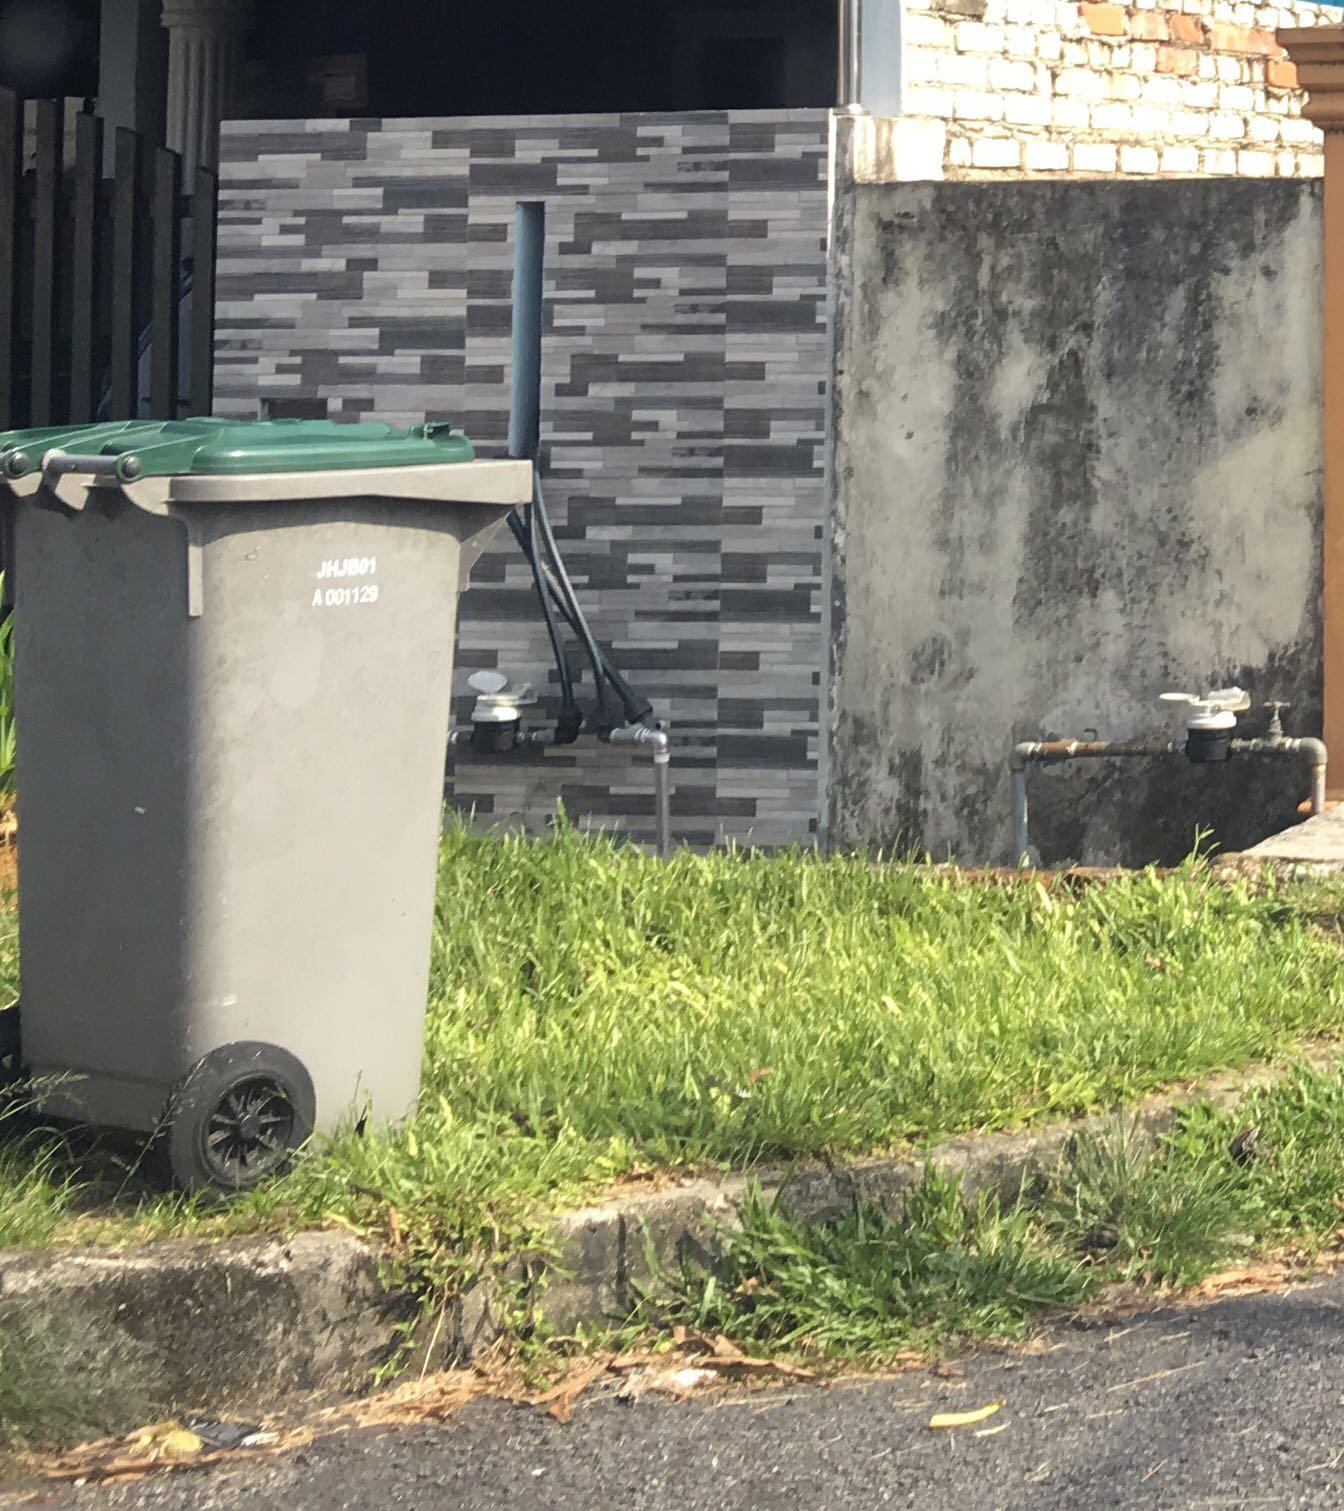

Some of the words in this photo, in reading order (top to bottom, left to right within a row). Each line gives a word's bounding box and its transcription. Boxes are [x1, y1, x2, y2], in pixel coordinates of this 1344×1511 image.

[316, 556, 376, 579] JHJB01
[311, 588, 322, 607] A
[325, 584, 379, 606] 001129
